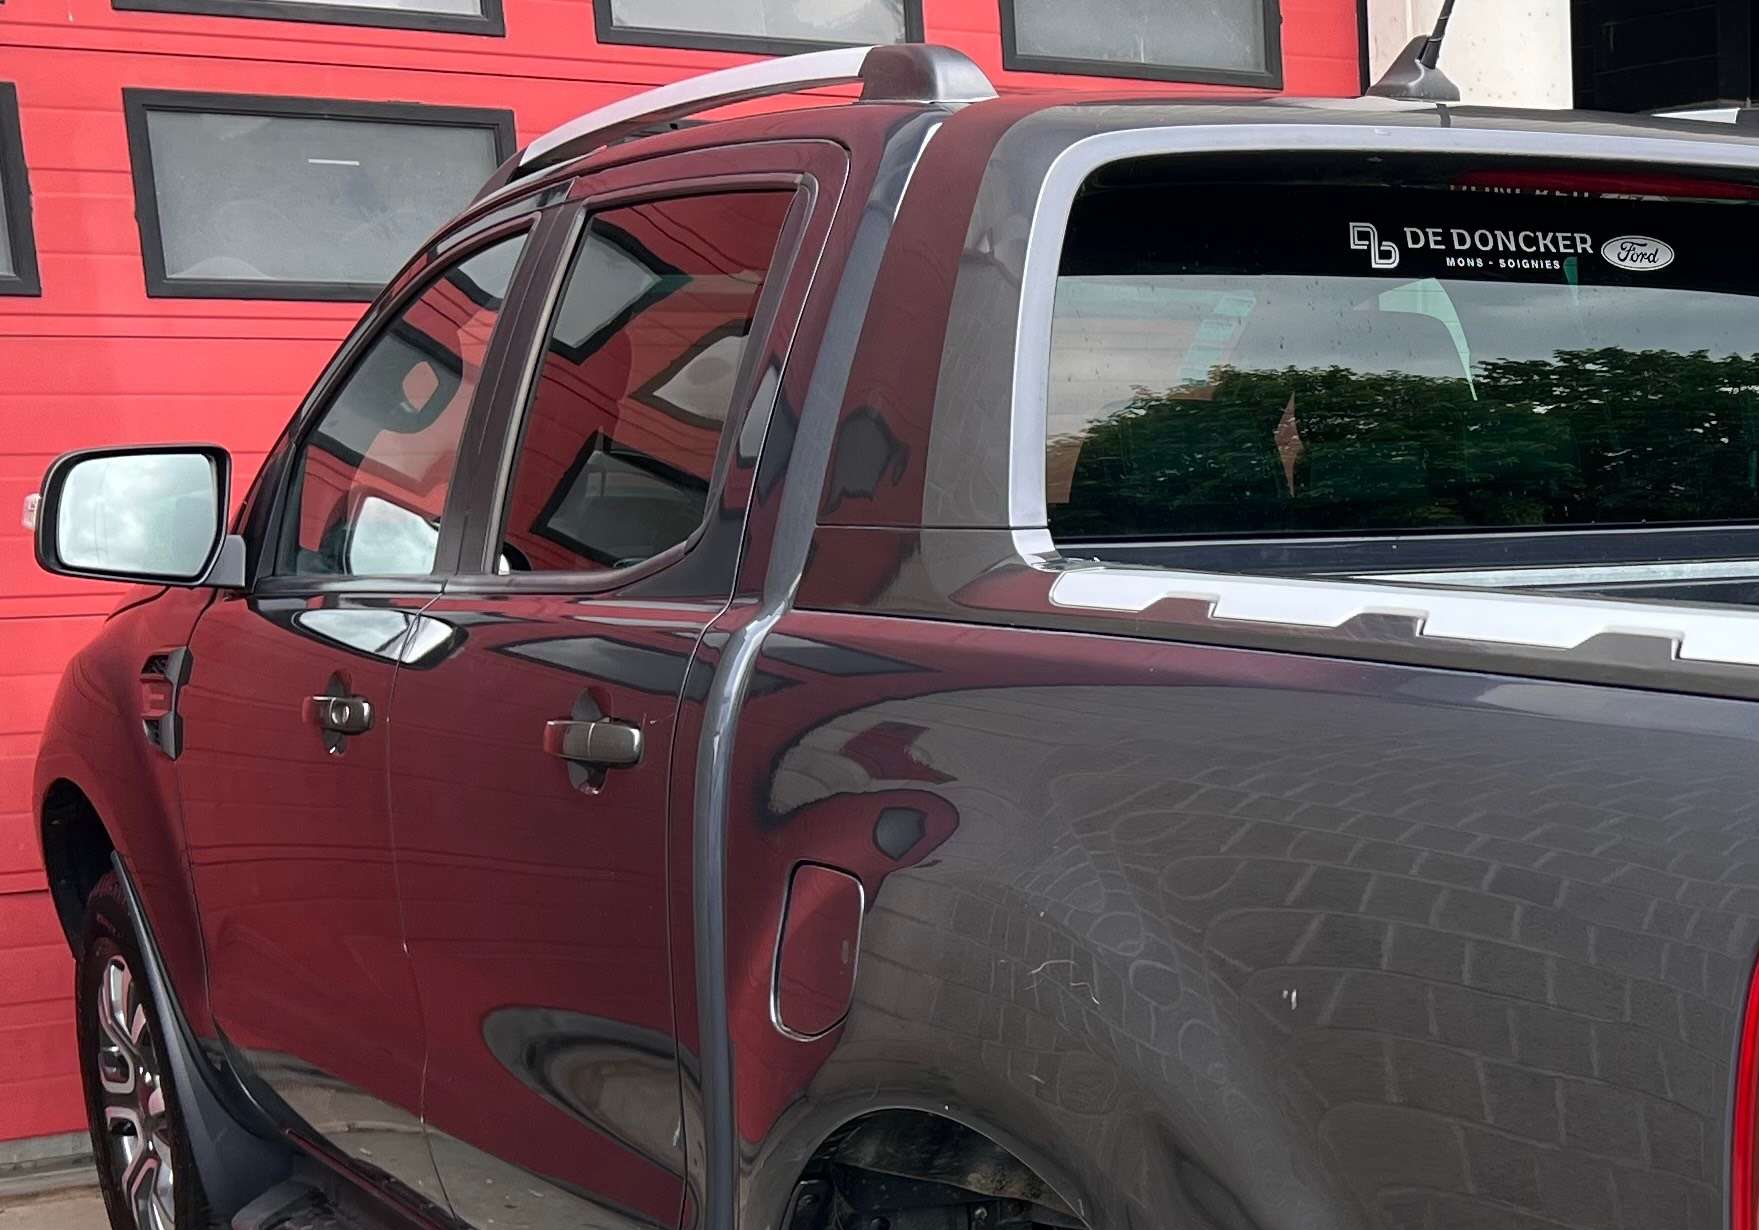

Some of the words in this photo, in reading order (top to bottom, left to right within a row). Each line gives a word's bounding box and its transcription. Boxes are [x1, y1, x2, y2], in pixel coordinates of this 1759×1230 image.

[1404, 226, 1446, 249] DE
[1450, 228, 1594, 254] DONCKER
[1446, 256, 1484, 267] MONS
[1499, 257, 1561, 270] SOIGNIES
[1617, 241, 1659, 264] Ford
